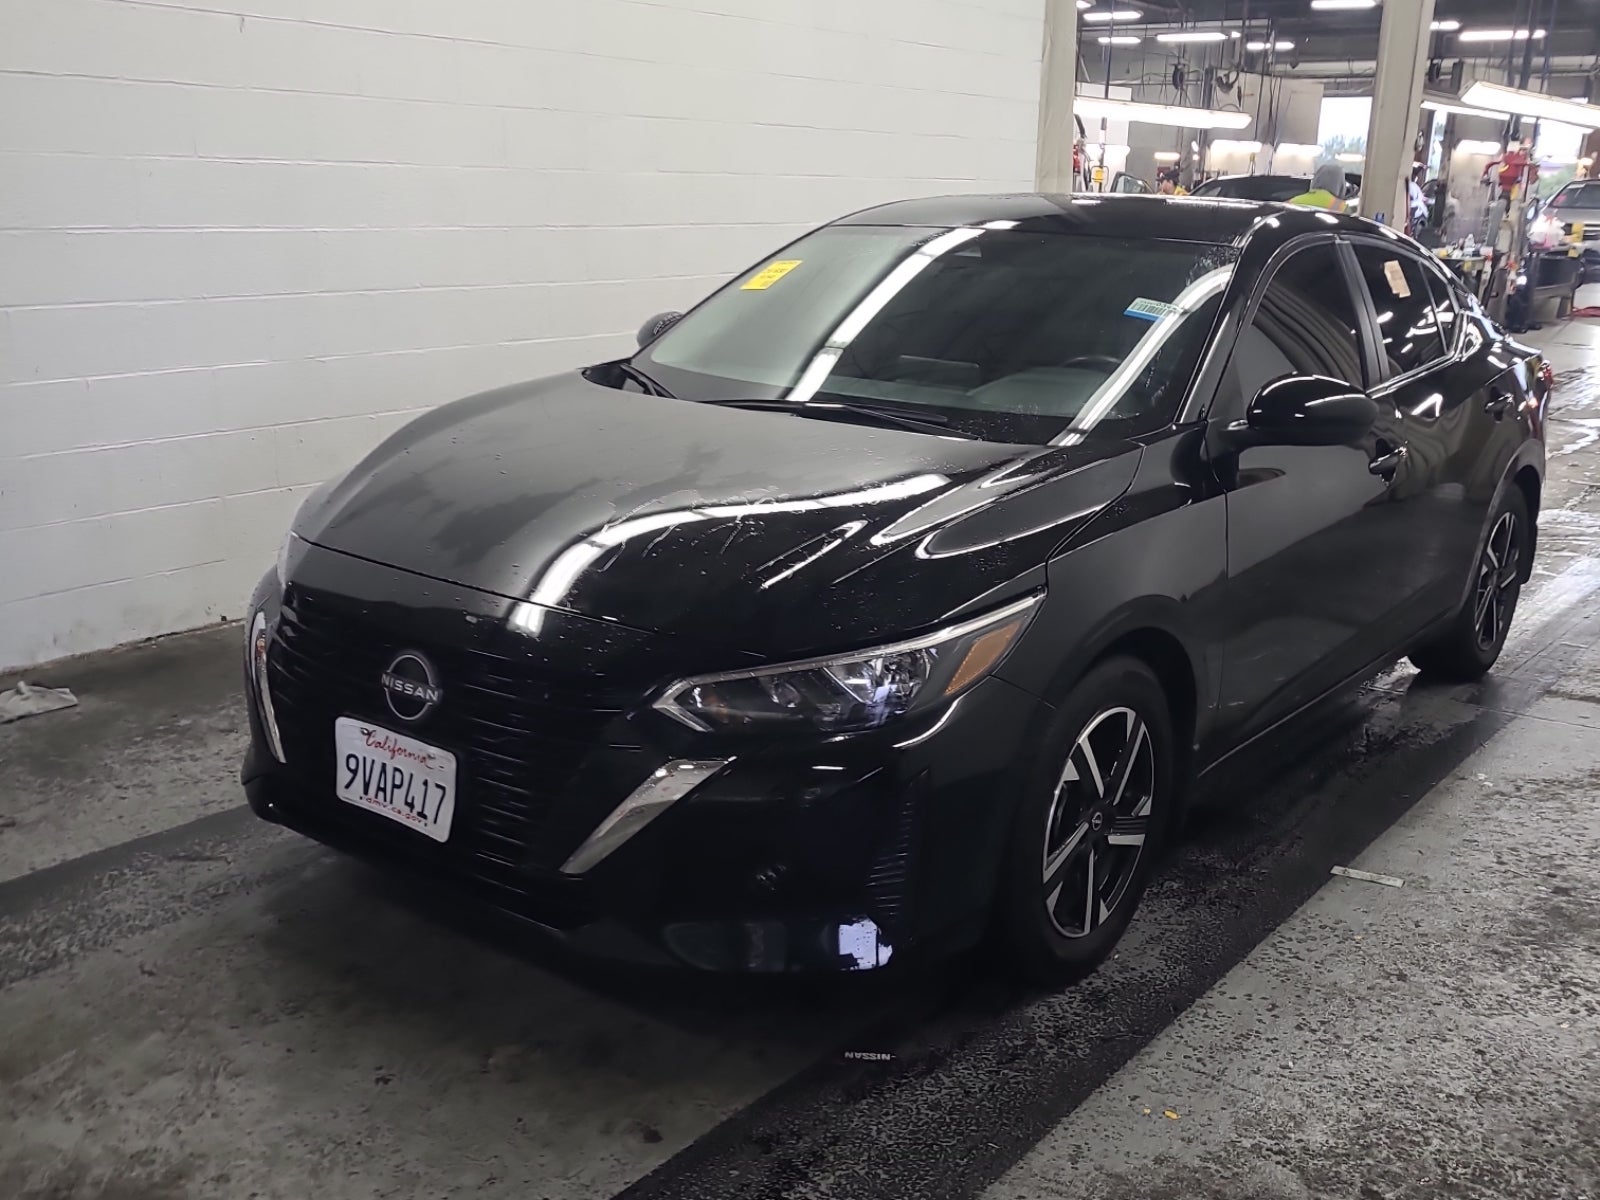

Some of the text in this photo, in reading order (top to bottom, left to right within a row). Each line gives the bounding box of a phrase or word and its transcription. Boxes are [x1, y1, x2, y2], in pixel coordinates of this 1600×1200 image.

[381, 673, 439, 702] NISSAN
[364, 729, 434, 770] California
[344, 753, 447, 825] 9VAP417
[844, 1051, 891, 1061] NISSAN
